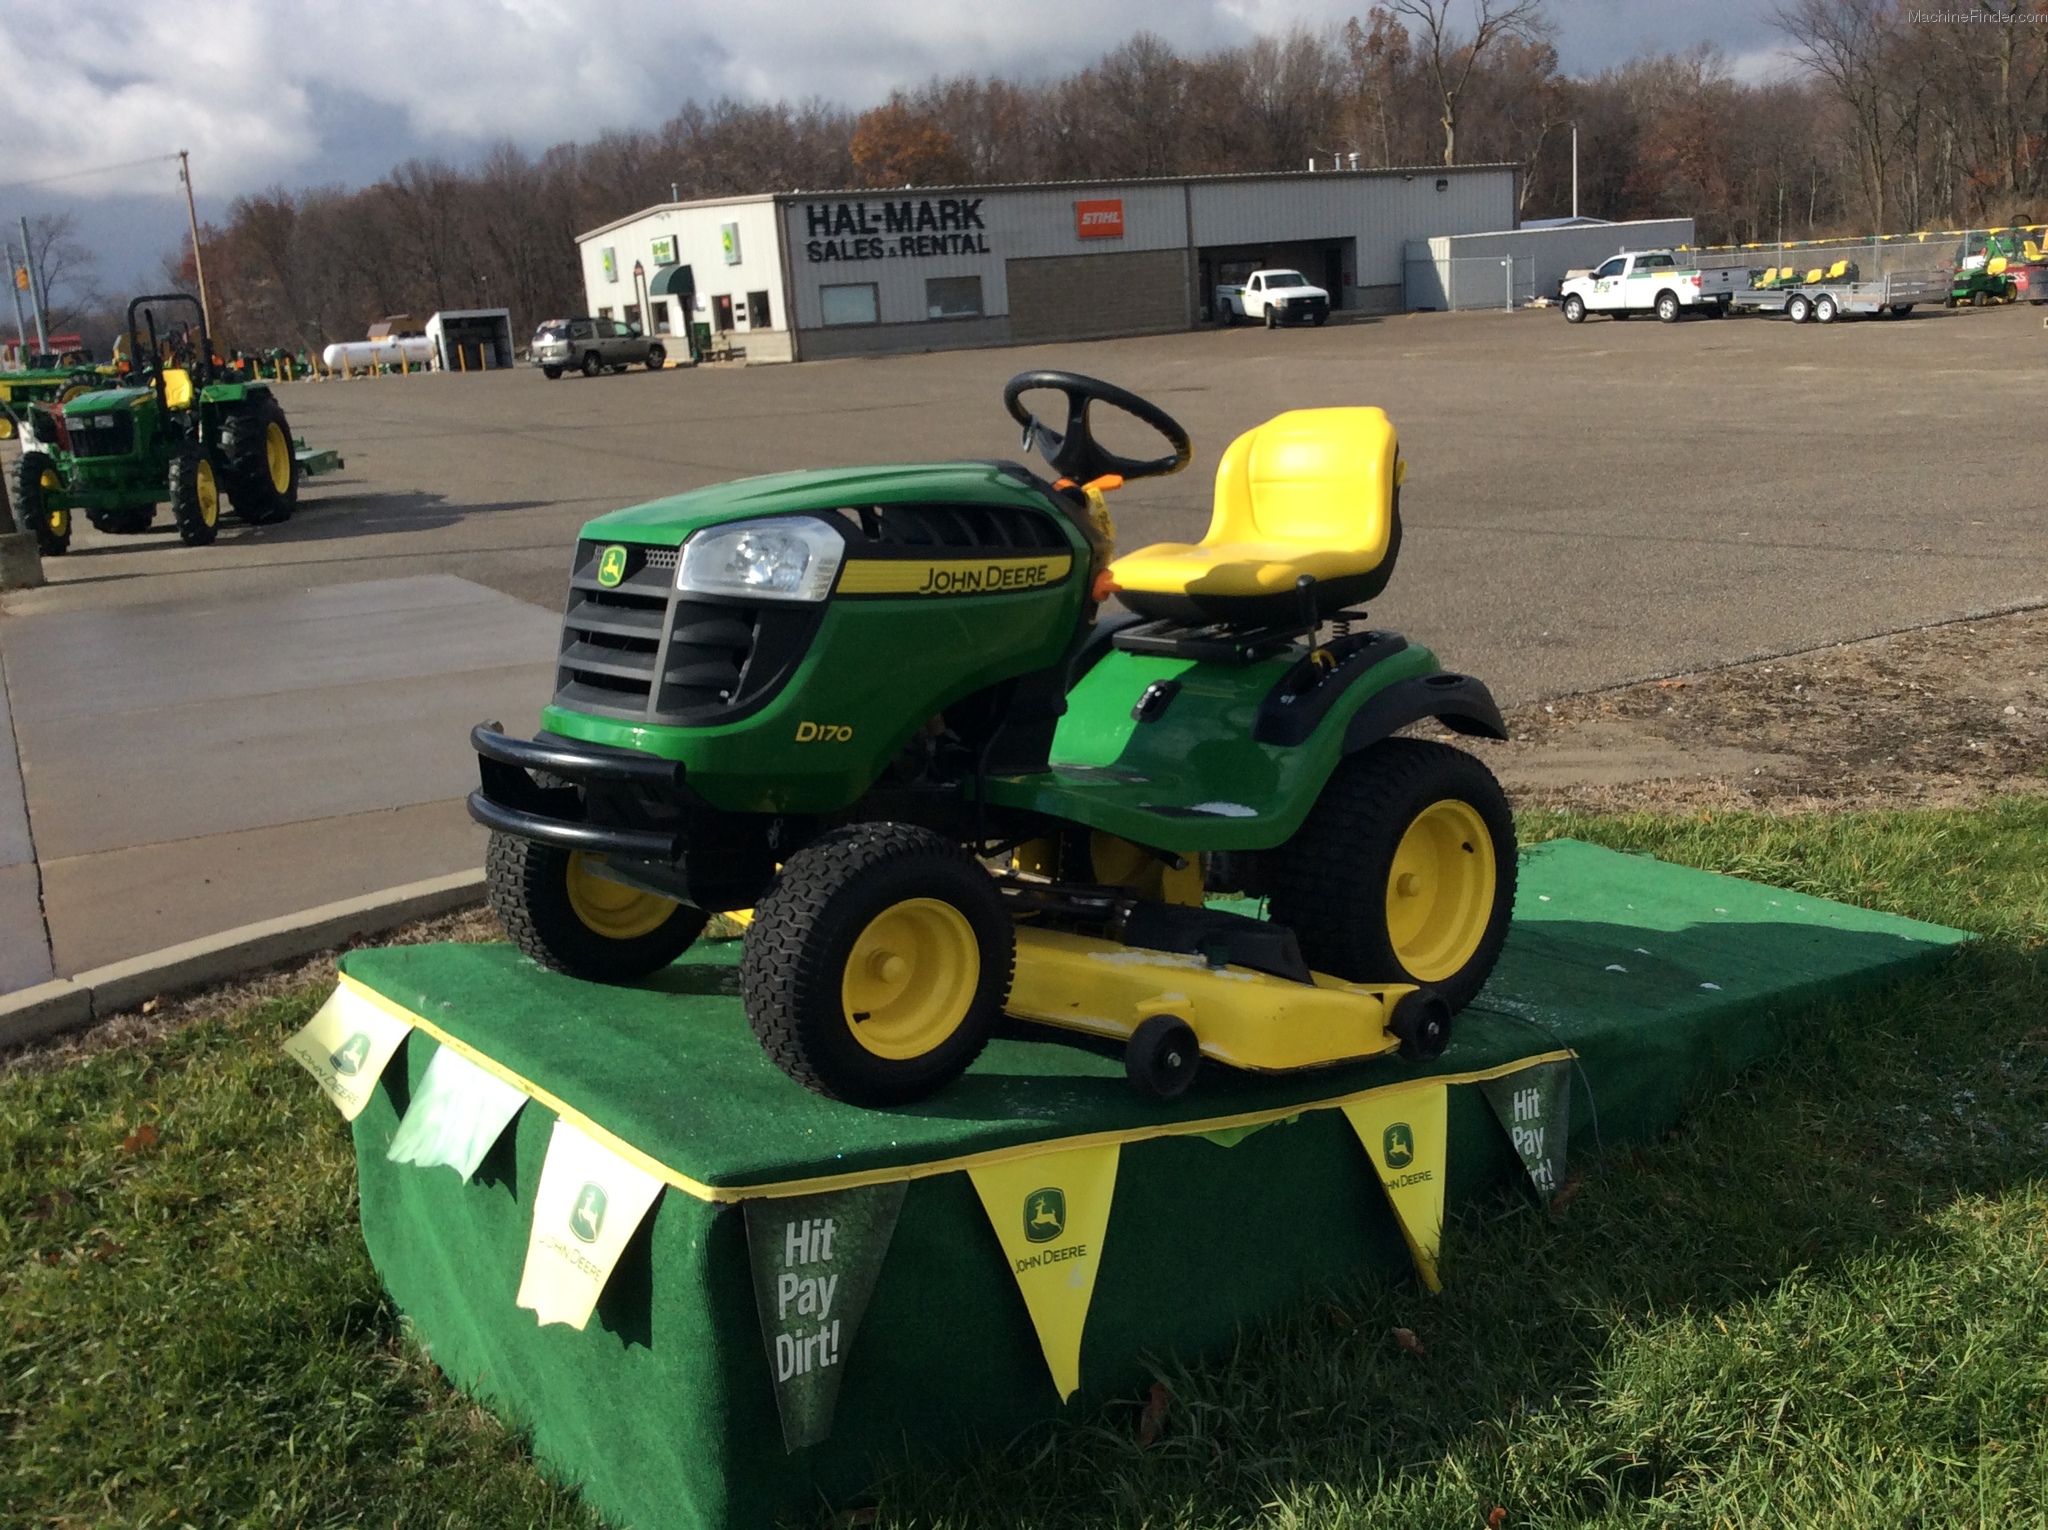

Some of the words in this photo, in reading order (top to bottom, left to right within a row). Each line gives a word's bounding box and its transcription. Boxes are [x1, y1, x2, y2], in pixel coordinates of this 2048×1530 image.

[807, 198, 985, 237] HAL-MARK
[1082, 211, 1121, 225] STIHL
[807, 237, 884, 263] SALES
[900, 233, 991, 257] RENTAL
[920, 567, 982, 591] JOHN
[986, 564, 1048, 588] DEERE
[795, 721, 853, 742] D170
[295, 1047, 327, 1077] JOHN
[324, 1075, 360, 1106] DEERE
[1513, 1087, 1541, 1122] Hit
[1512, 1126, 1544, 1160] Pay
[1400, 1170, 1433, 1188] DEERE
[538, 1232, 570, 1259] JOHN
[570, 1248, 602, 1283] DEERE
[785, 1218, 836, 1268] Hit
[1015, 1254, 1041, 1275] JOHN
[1043, 1244, 1087, 1265] DEERE
[778, 1272, 838, 1321] Pay
[776, 1319, 840, 1383] Dirt!
